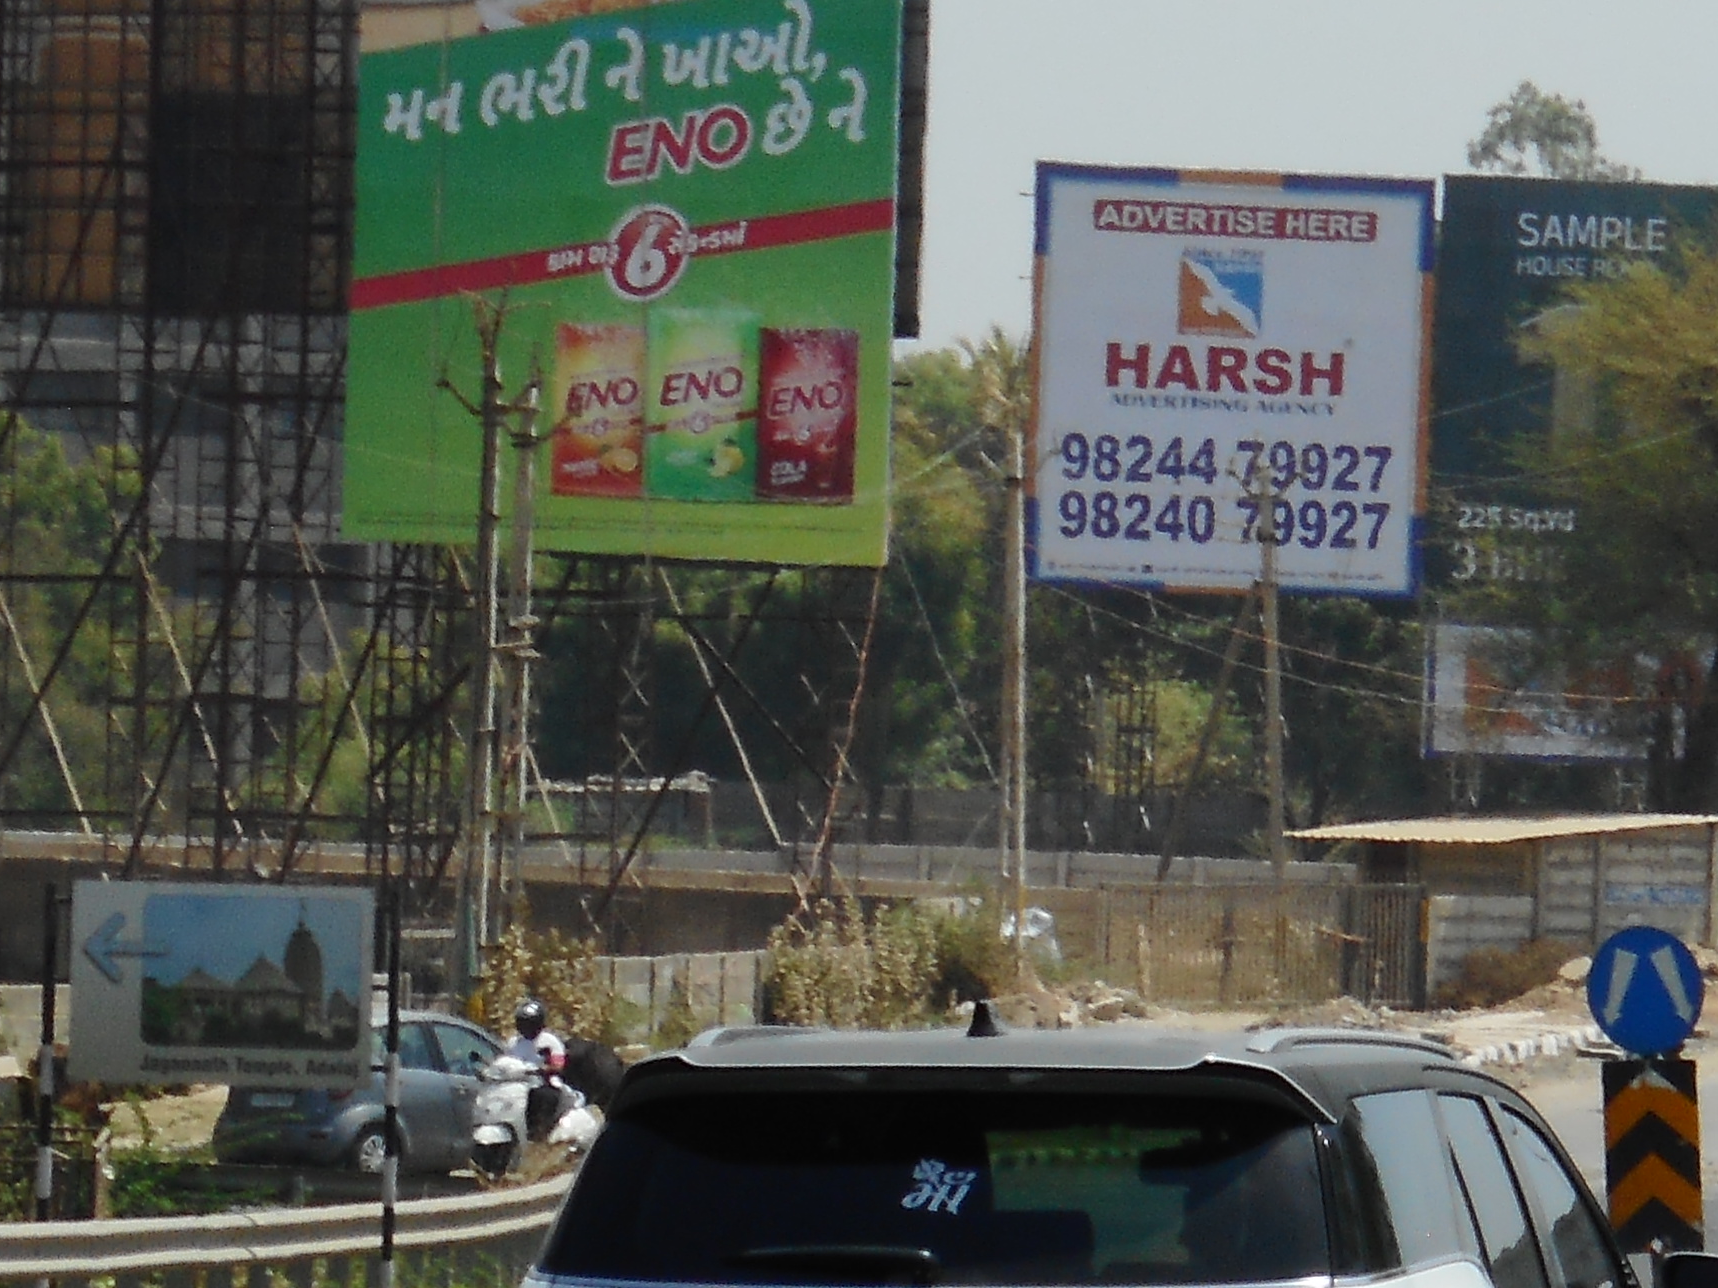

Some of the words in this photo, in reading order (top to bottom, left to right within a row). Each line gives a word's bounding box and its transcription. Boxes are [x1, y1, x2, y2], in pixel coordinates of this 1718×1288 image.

[383, 81, 464, 141] મન
[482, 39, 591, 126] ભરી
[605, 27, 644, 102] ને
[606, 105, 751, 185] ENO
[762, 76, 814, 155] છે
[828, 67, 868, 143] ને
[1099, 203, 1274, 234] ADVERTISE
[1286, 213, 1369, 239] HERE
[1517, 212, 1668, 252] SAMPLE
[624, 224, 666, 287] 6
[1516, 255, 1586, 277] HOUSE
[659, 366, 744, 407] ENO
[1106, 342, 1345, 396] HARSH
[567, 376, 639, 416] ENO
[770, 380, 843, 418] ENO
[1062, 433, 1217, 485] 98244
[1236, 440, 1392, 493] 79927
[1059, 490, 1215, 544] 98240
